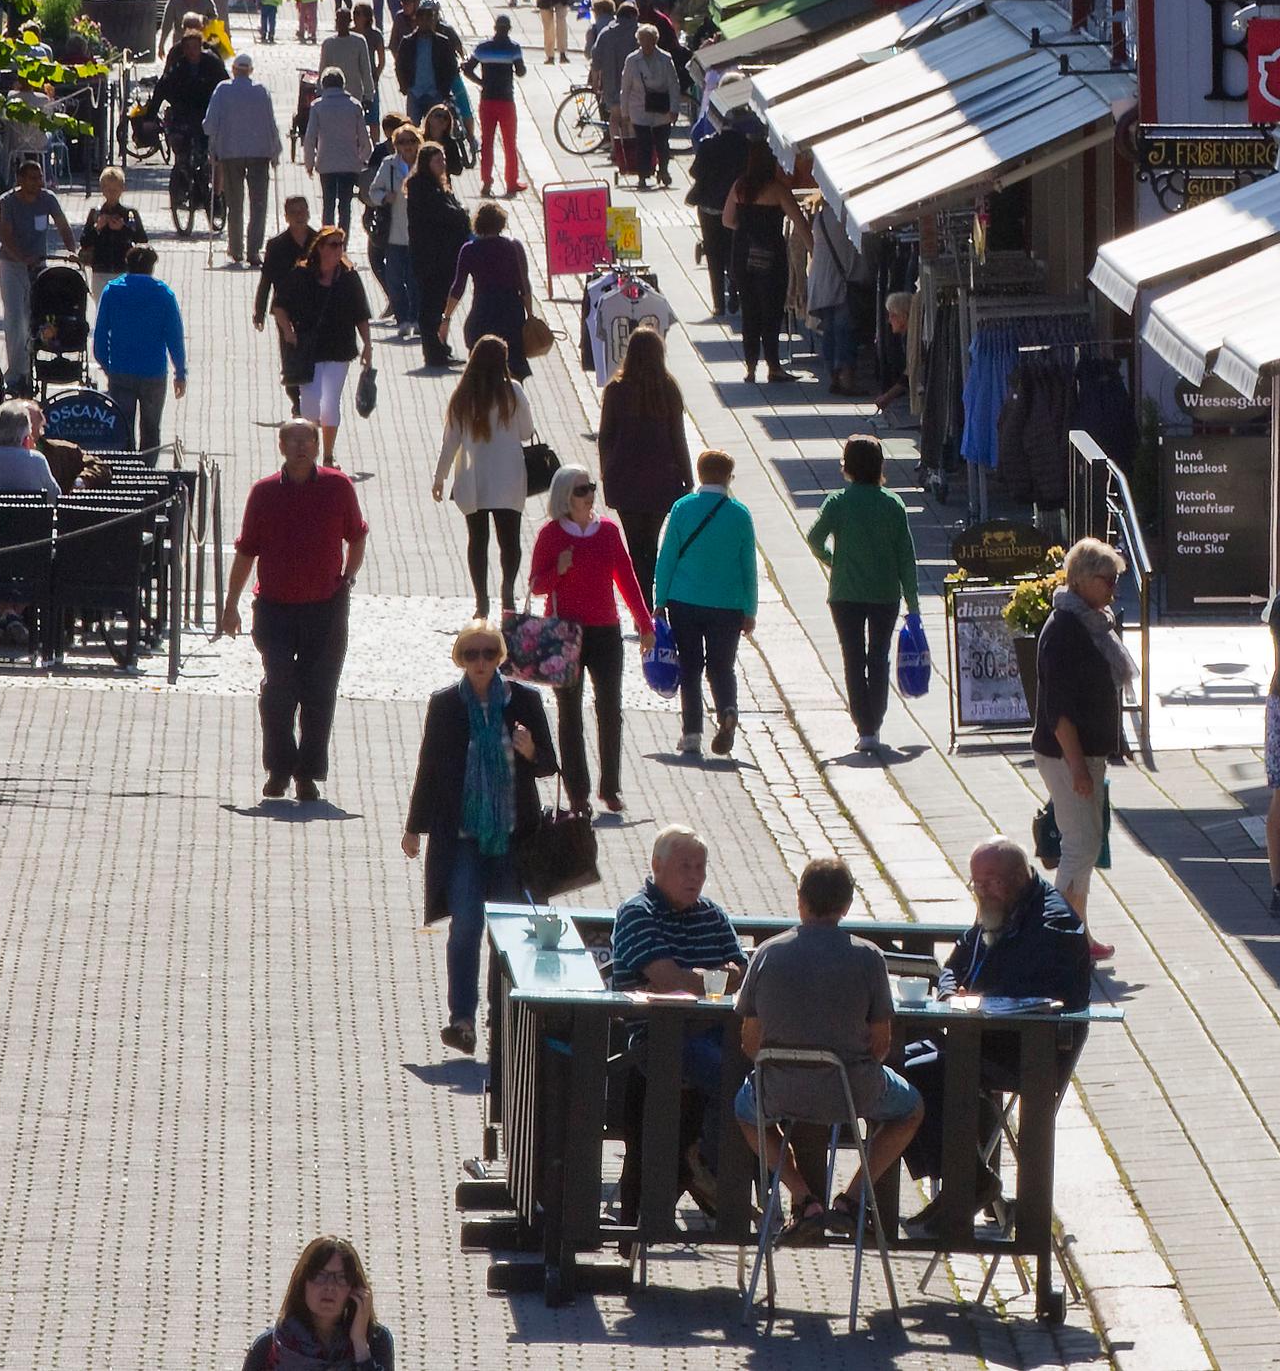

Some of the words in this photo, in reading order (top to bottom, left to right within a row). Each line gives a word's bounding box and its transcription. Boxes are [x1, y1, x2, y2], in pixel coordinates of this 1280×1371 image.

[1176, 141, 1279, 166] FRISENBERG
[553, 194, 601, 224] SALG
[1183, 393, 1272, 410] Wiesesgate
[49, 404, 116, 429] OSCANA
[1175, 450, 1204, 461] Linné
[1175, 463, 1228, 474] Helsekost
[1175, 491, 1216, 502] Victoria
[1176, 504, 1235, 515] Herrefrisør
[1177, 531, 1231, 544] Falkanger
[1177, 544, 1203, 554] Euro
[1204, 544, 1225, 554] Sko
[956, 602, 1002, 618] diam
